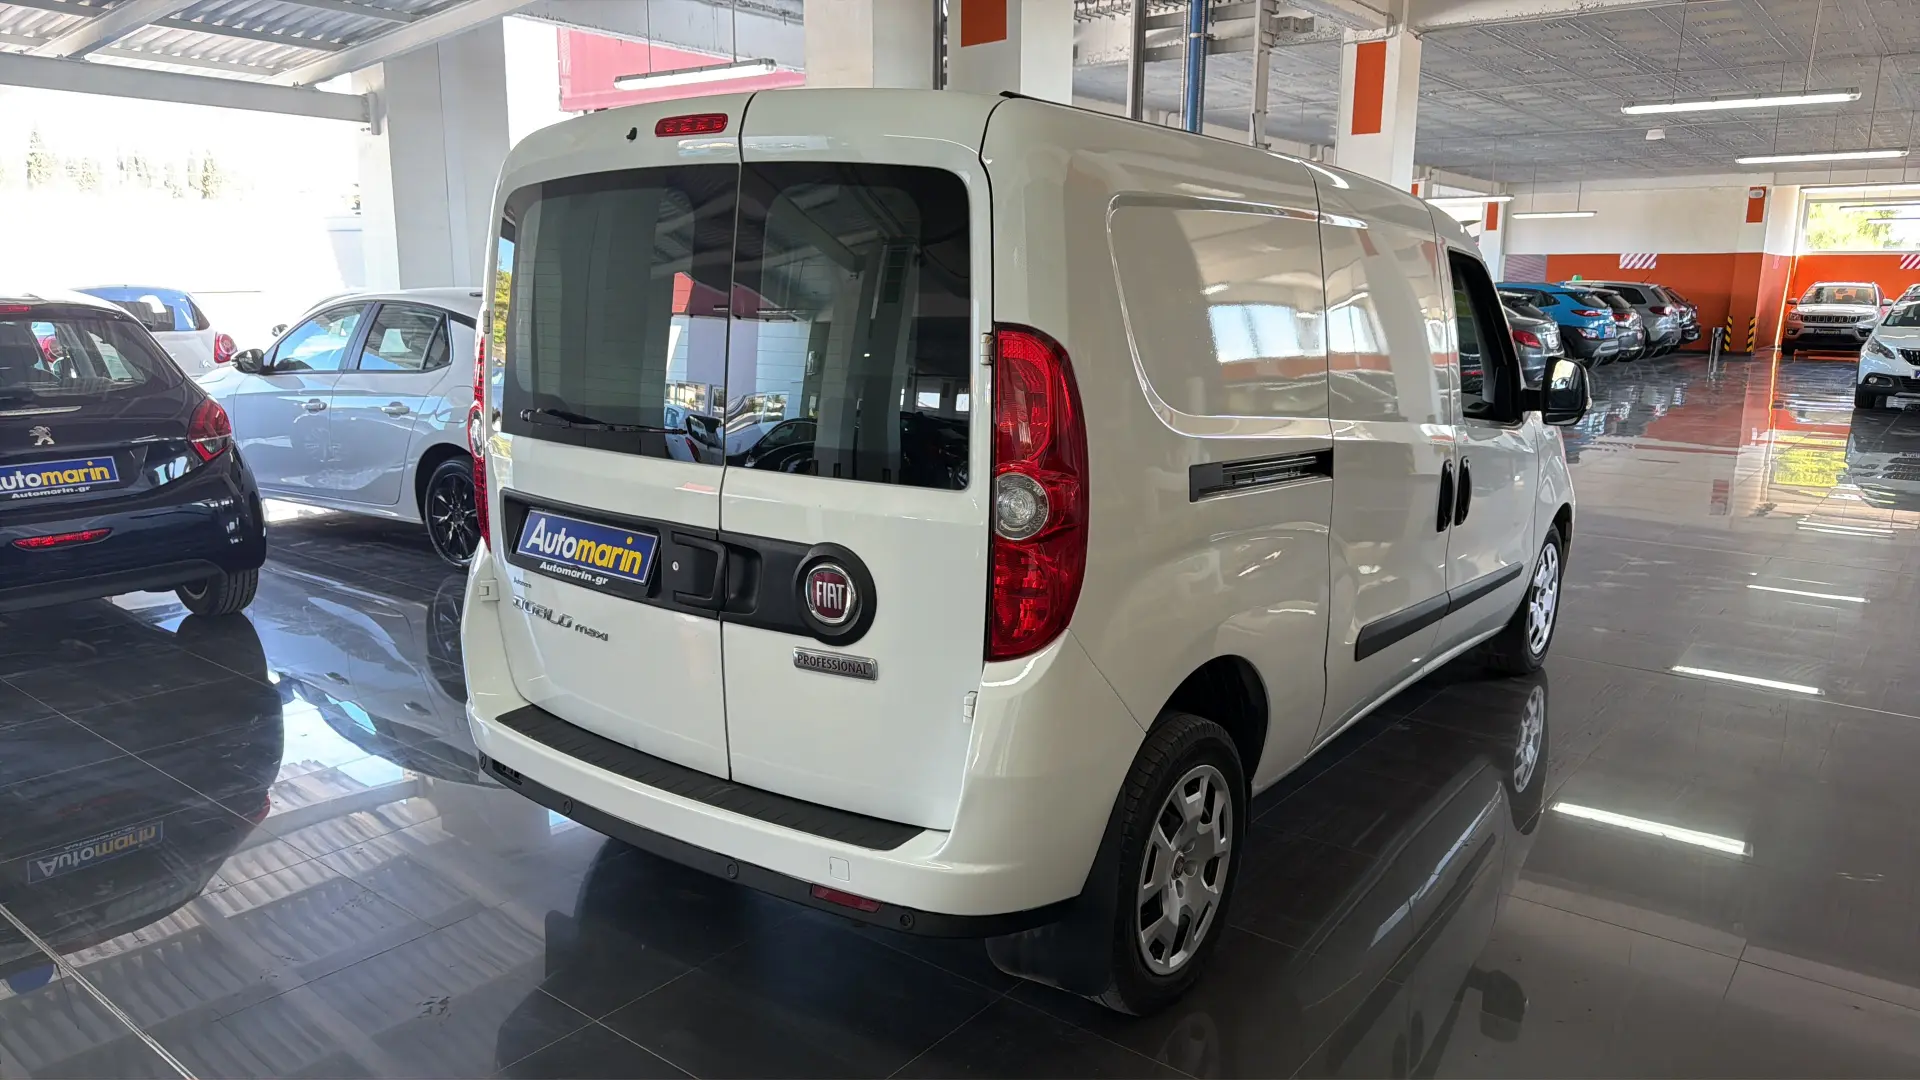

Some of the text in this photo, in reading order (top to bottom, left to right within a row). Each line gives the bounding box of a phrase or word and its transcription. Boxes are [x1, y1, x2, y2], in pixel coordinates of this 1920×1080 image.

[0, 460, 110, 491] utomarin
[525, 517, 643, 575] Automarin
[539, 561, 609, 585] Automarin.gr
[815, 580, 845, 610] FIAT
[797, 654, 869, 675] PROFESSIONAL
